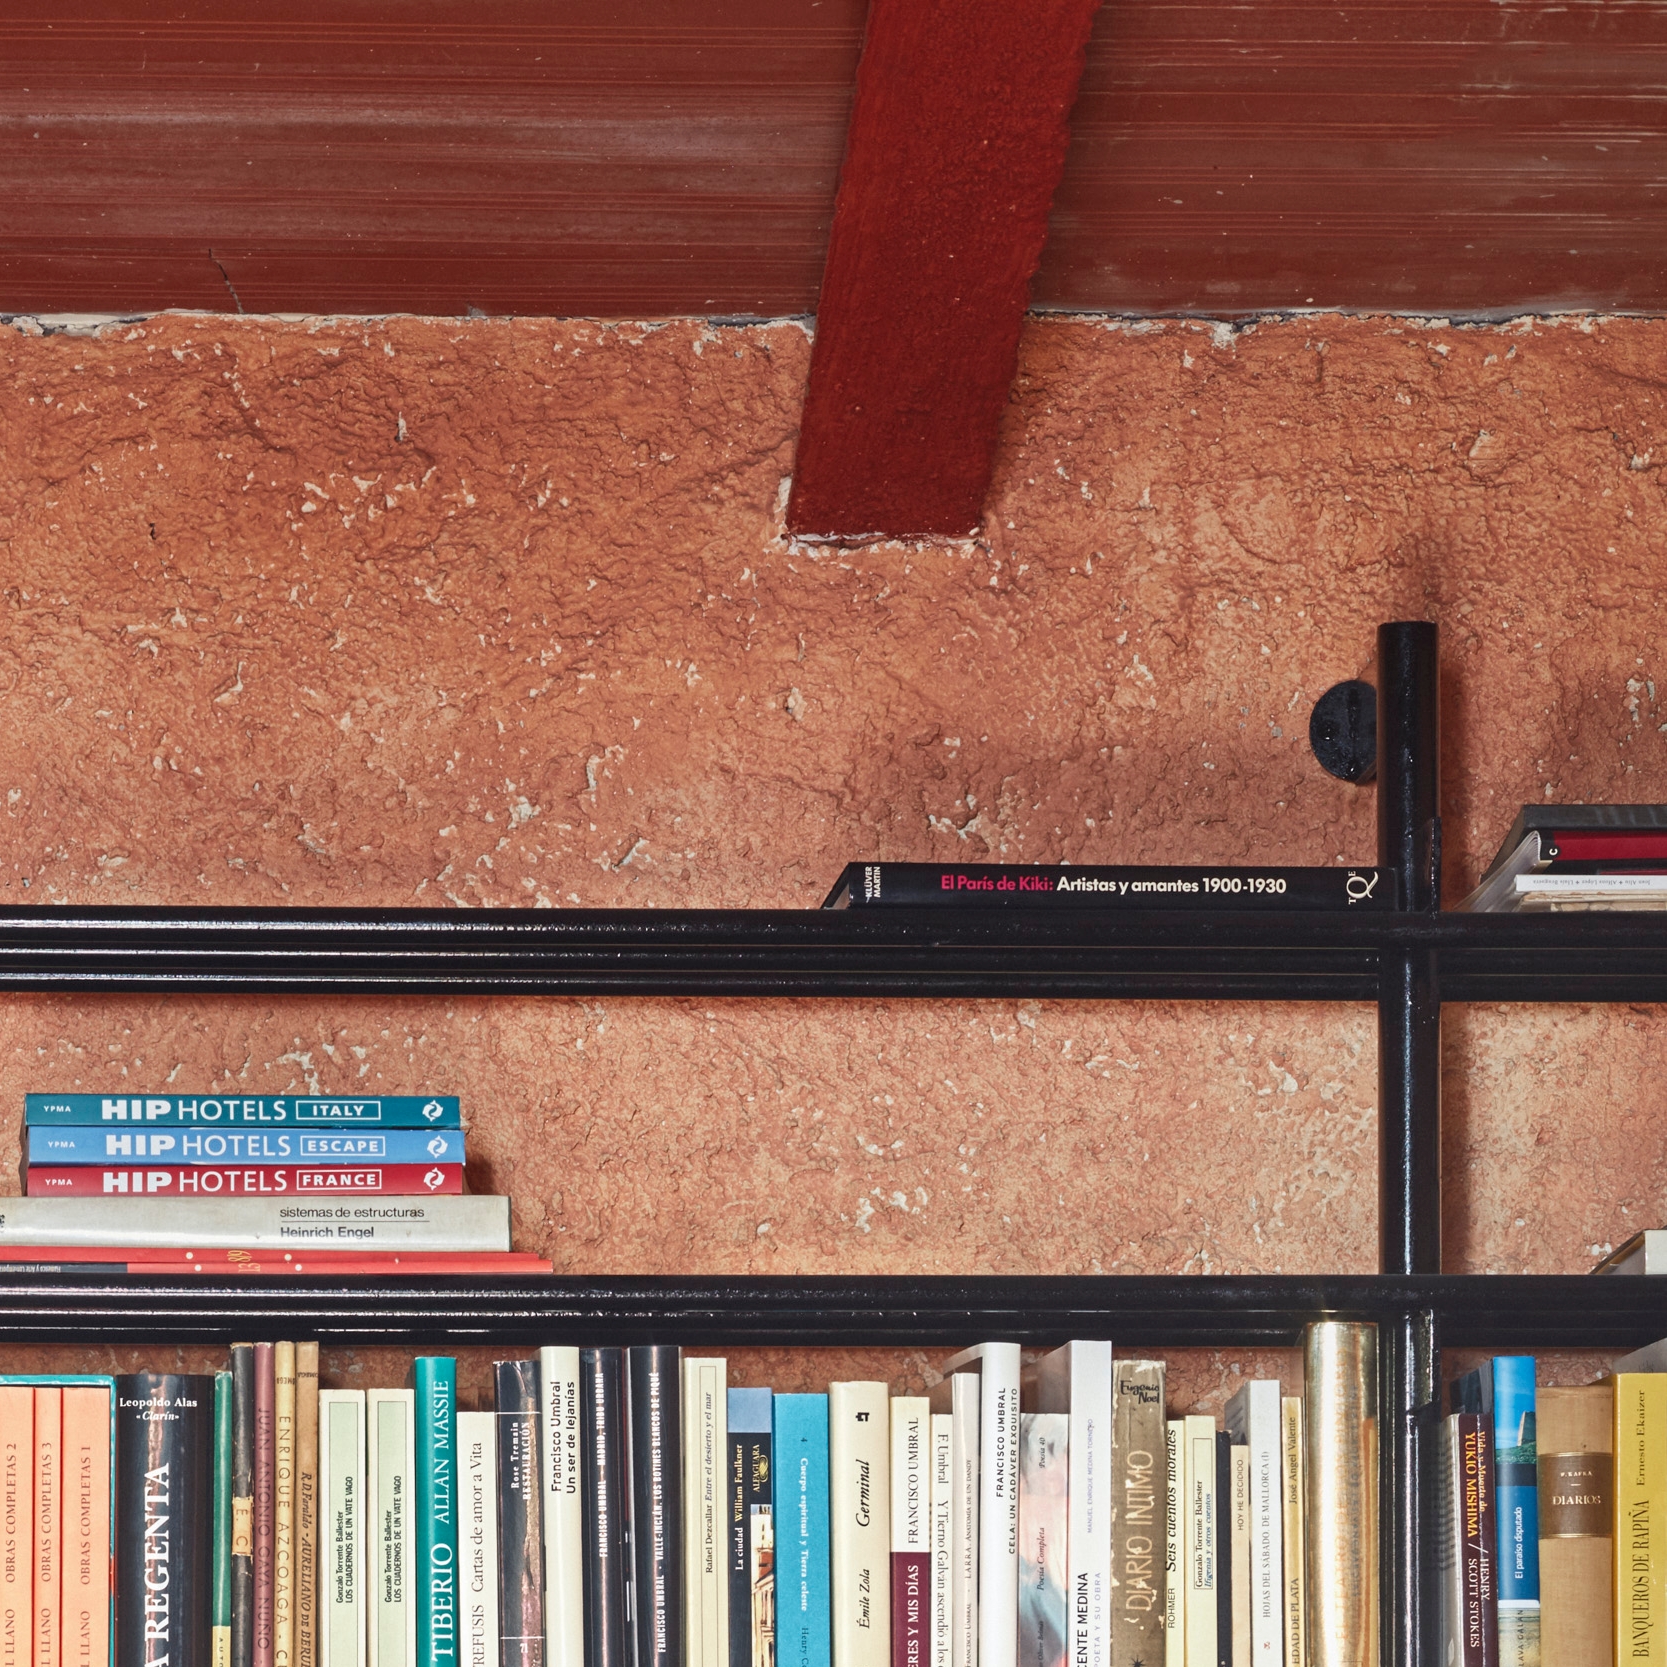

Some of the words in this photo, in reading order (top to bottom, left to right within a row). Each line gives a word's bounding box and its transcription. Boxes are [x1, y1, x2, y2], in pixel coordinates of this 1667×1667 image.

[864, 866, 873, 898] KLÜVER
[873, 866, 882, 898] MARTIN
[941, 875, 954, 890] El
[957, 875, 994, 890] París
[997, 875, 1016, 891] de
[1019, 876, 1053, 890] Kiki:
[1056, 876, 1116, 892] Artistas
[1118, 881, 1129, 895] y
[1131, 879, 1199, 892] amantes
[1202, 878, 1286, 893] 1900-1930
[102, 1100, 171, 1120] HIP
[179, 1100, 286, 1120] HOTELS
[313, 1105, 364, 1116] ITALY
[106, 1135, 175, 1155] HIP
[183, 1135, 290, 1156] HOTELS
[308, 1140, 378, 1152] ESCAPE
[103, 1172, 172, 1192] HIP
[180, 1171, 287, 1192] HOTELS
[303, 1174, 375, 1186] FRANCE
[280, 1207, 333, 1218] sistemas
[335, 1207, 351, 1218] de
[354, 1208, 425, 1217] estructuras
[280, 1227, 333, 1237] Heinrich
[338, 1226, 374, 1238] Engel
[119, 1396, 171, 1411] Leopoldo
[174, 1397, 197, 1408] Alas
[433, 1381, 449, 1449] MASSIE
[550, 1381, 561, 1427] Umbral
[564, 1382, 577, 1430] lejanías
[566, 1434, 575, 1449] de
[908, 1417, 918, 1470] UMBRAL
[550, 1431, 561, 1492] Francisco
[568, 1453, 576, 1472] ser
[6, 1455, 16, 1535] COMPLETAS
[433, 1458, 449, 1524] ALLAN
[566, 1477, 576, 1494] Un
[855, 1459, 870, 1527] Germinal
[1553, 1495, 1602, 1505] DIARIOS
[908, 1474, 918, 1543] FRANCISCO
[1628, 1500, 1649, 1550] RAPIÑA
[5, 1539, 15, 1583] OBRAS
[142, 1463, 170, 1642] REGENTA
[1632, 1553, 1649, 1572] DE
[905, 1565, 918, 1595] DÍAS
[430, 1543, 453, 1662] TIBERIO
[908, 1599, 919, 1622] MIS
[1077, 1573, 1088, 1624] MEDINA
[5, 1609, 15, 1653] LLANO
[908, 1627, 919, 1636] Y
[1632, 1575, 1654, 1658] BANQUEROS
